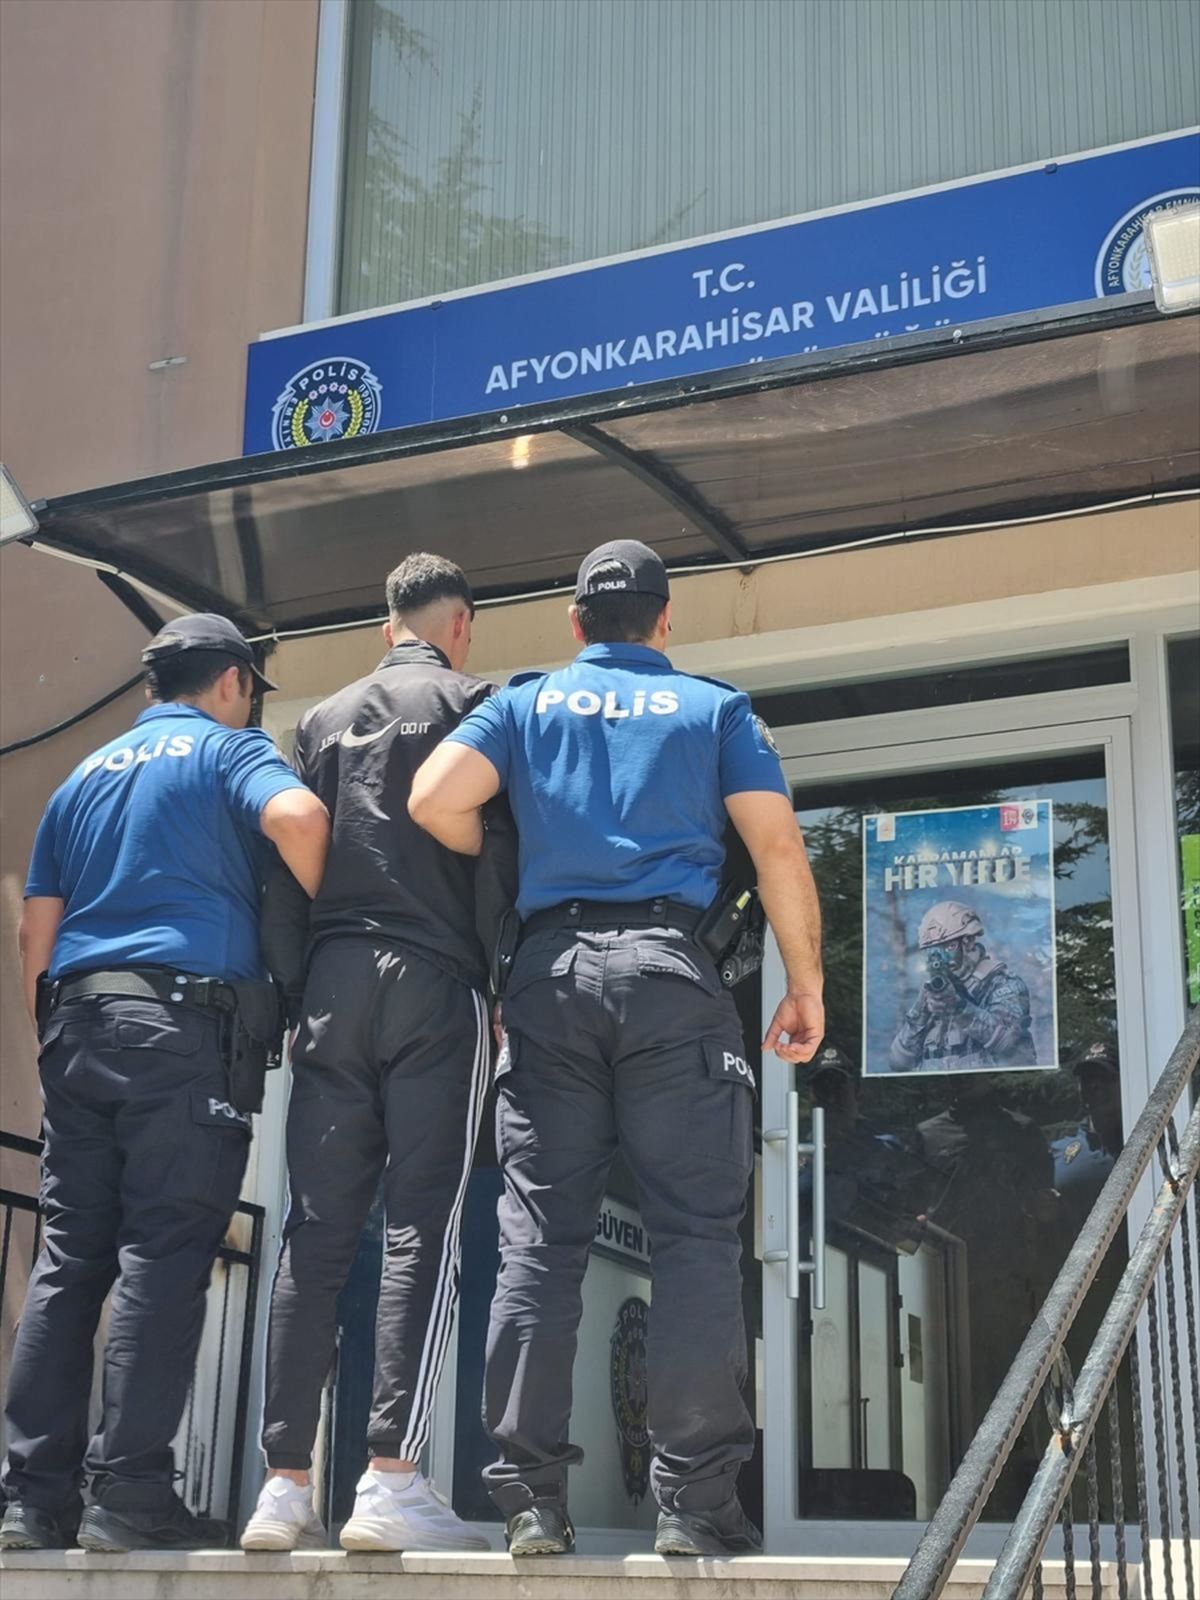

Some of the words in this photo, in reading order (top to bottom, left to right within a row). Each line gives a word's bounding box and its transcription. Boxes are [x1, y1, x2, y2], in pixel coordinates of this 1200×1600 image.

[692, 263, 755, 298] T.C.
[485, 301, 815, 394] AFYONKARAHİSAR
[825, 256, 986, 323] VALİLİĞİ
[298, 362, 359, 390] POLİS
[400, 722, 417, 735] DO
[419, 722, 431, 734] IT
[884, 863, 939, 892] HER
